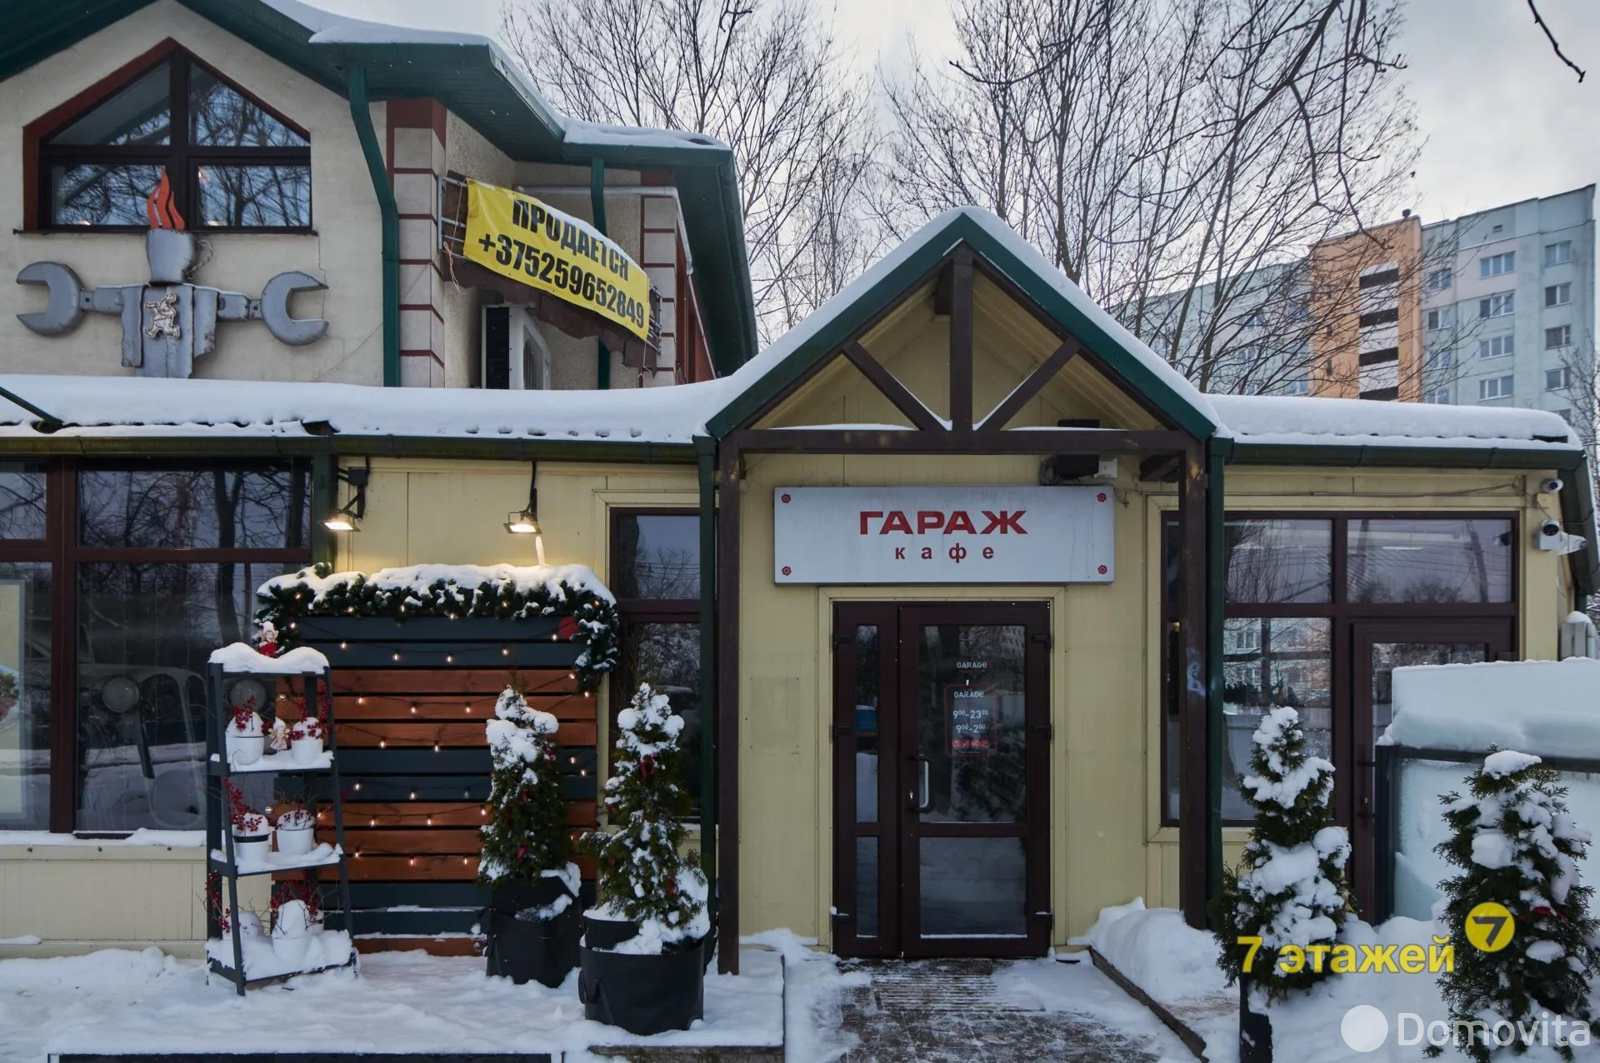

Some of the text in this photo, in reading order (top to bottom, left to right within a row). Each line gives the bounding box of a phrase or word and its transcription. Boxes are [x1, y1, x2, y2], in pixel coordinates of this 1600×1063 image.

[512, 199, 629, 281] ПРОДАЕТСЯ
[478, 233, 645, 329] +375259652849
[859, 510, 1029, 535] ГАРАЖ
[895, 543, 994, 563] кафе
